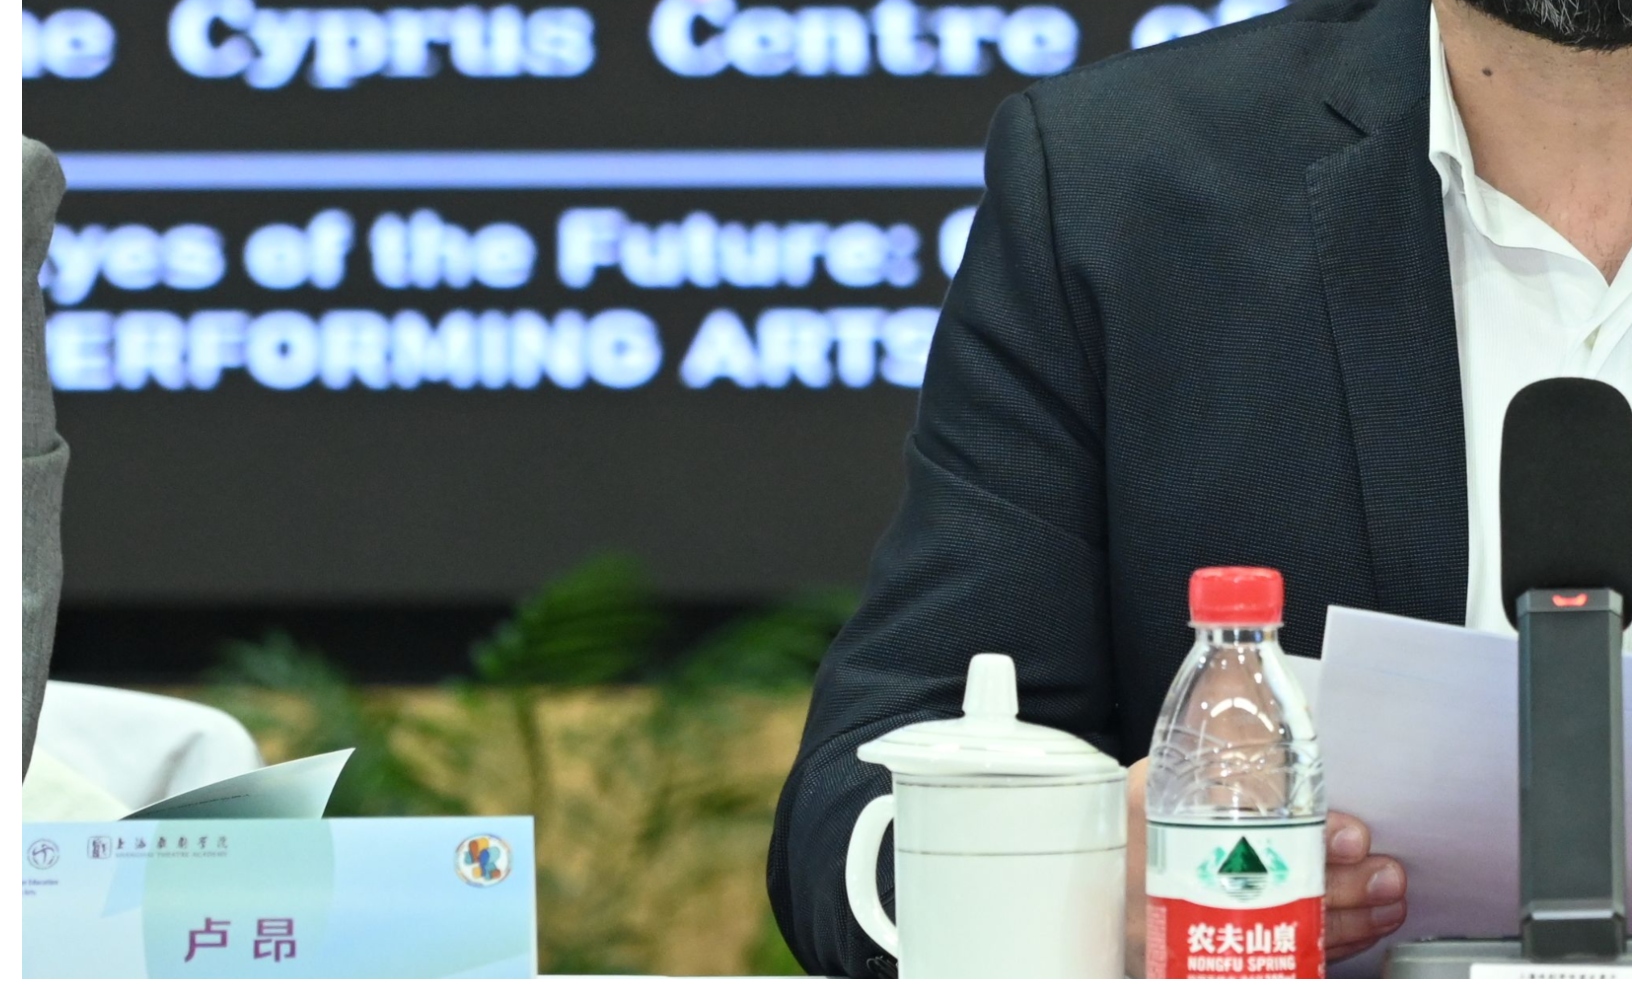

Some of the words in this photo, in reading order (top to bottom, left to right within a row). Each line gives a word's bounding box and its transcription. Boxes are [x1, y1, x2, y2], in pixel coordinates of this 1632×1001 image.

[243, 209, 354, 290] of
[368, 209, 538, 290] the
[555, 208, 921, 290] Future:
[46, 308, 664, 391] ERFORMING
[679, 308, 943, 390] ARTS
[184, 917, 298, 963] 卢昂
[1187, 922, 1297, 954] 农夫山泉
[1187, 955, 1244, 972] NONGFU
[1247, 954, 1297, 972] SPRING
